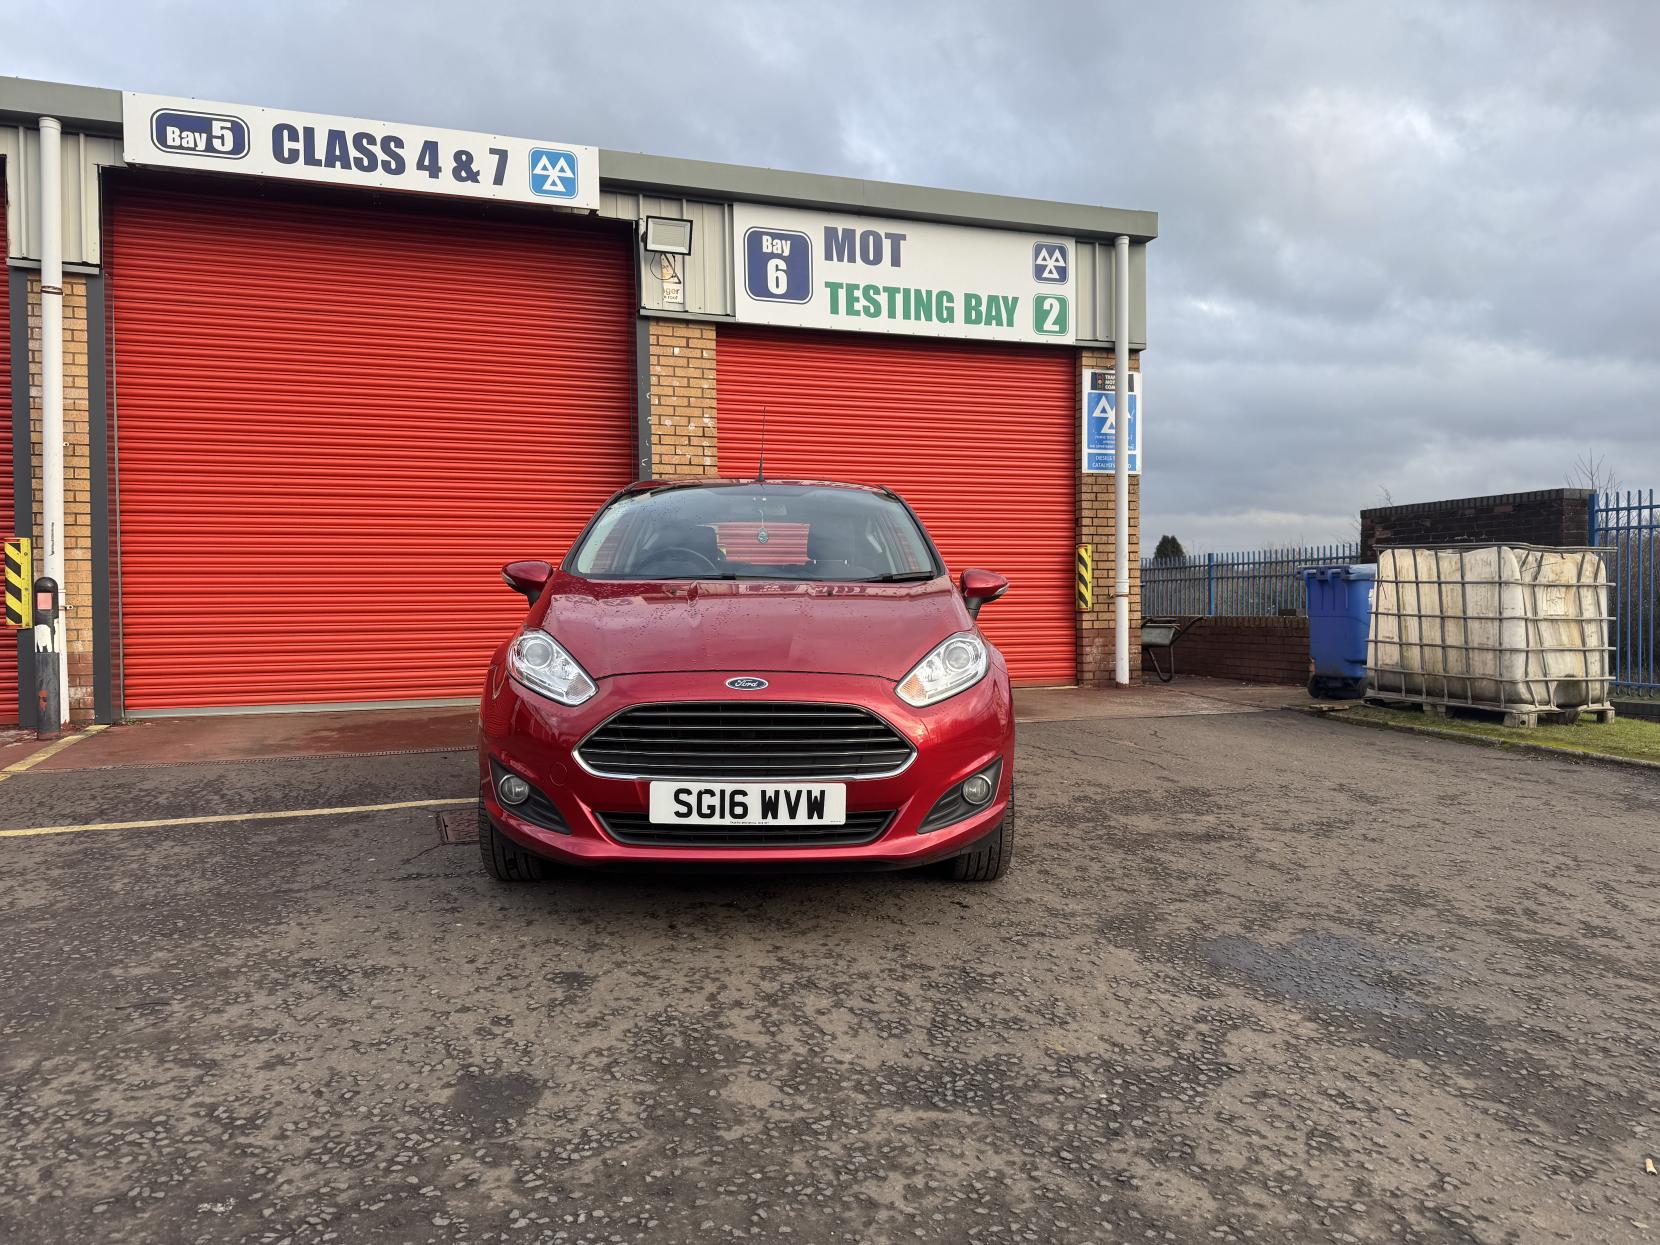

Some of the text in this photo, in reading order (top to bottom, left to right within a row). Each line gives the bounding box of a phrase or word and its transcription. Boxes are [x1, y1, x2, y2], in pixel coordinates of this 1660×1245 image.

[165, 121, 234, 152] Bay 5
[271, 123, 508, 186] CLASS 4 & 7
[762, 235, 791, 256] Bay
[823, 226, 907, 268] MOT
[766, 258, 787, 296] 6
[824, 281, 1020, 328] TESTING BAY
[1042, 297, 1061, 332] 2
[734, 679, 759, 687] Ford
[673, 788, 826, 820] SG16 WVW
